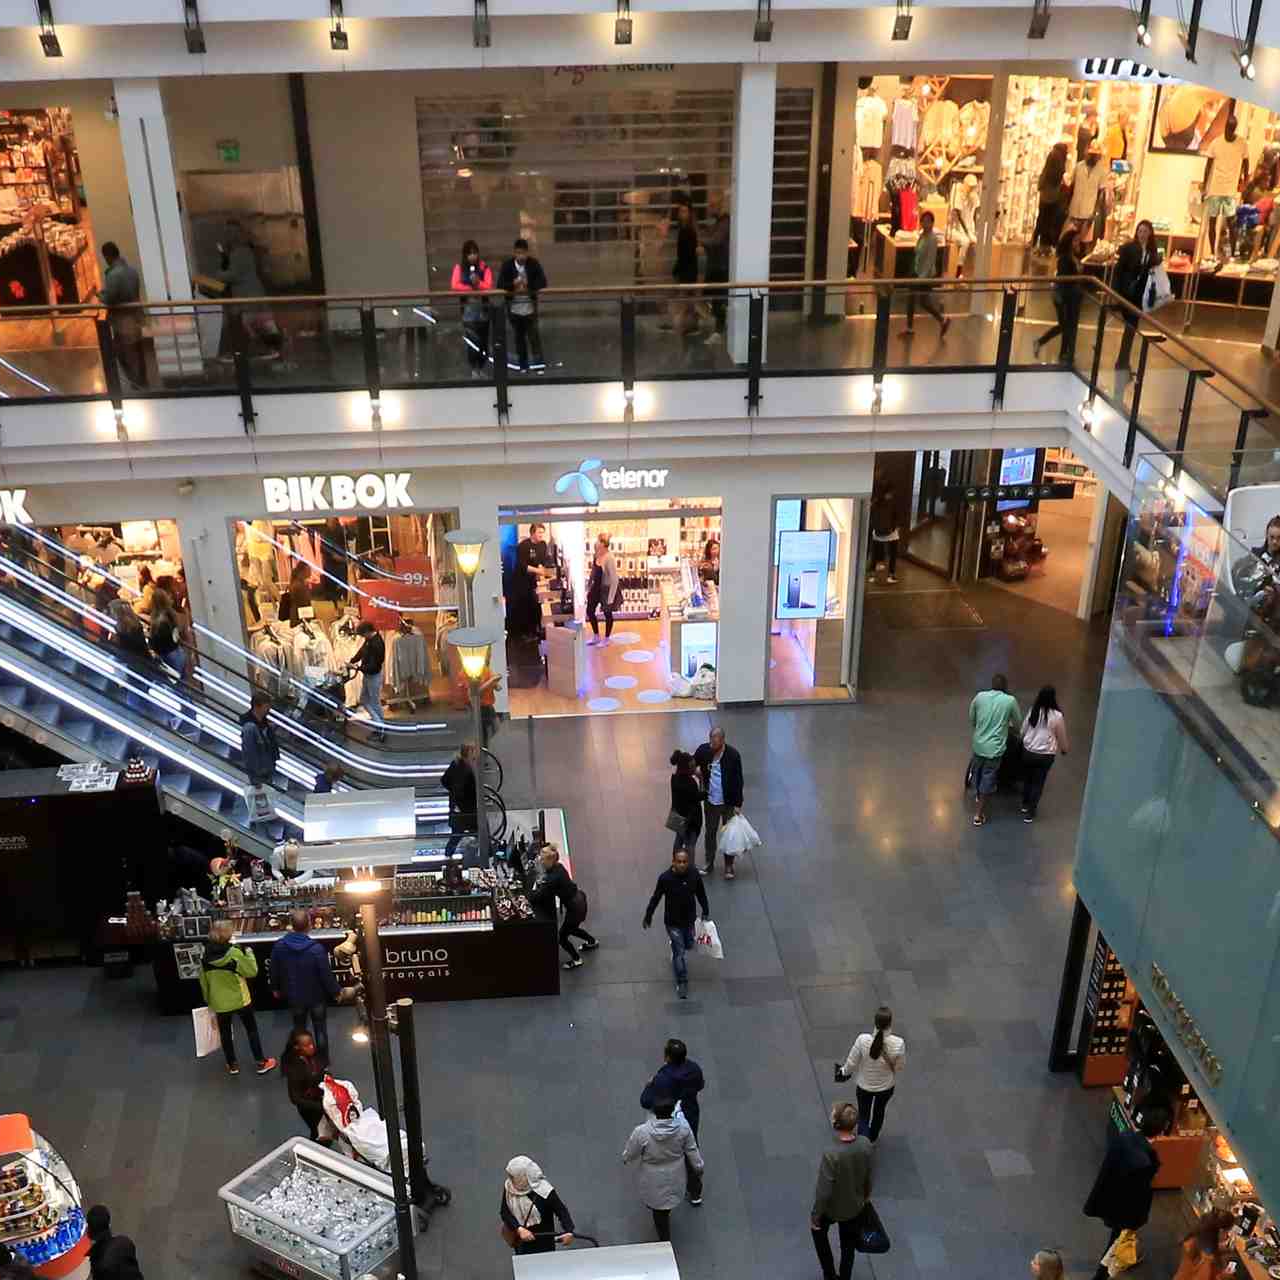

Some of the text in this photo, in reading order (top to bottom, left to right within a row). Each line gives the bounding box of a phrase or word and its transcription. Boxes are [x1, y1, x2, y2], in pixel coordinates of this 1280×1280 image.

[600, 466, 669, 490] telenor
[263, 473, 415, 512] BIK BOK
[385, 948, 449, 964] bruno
